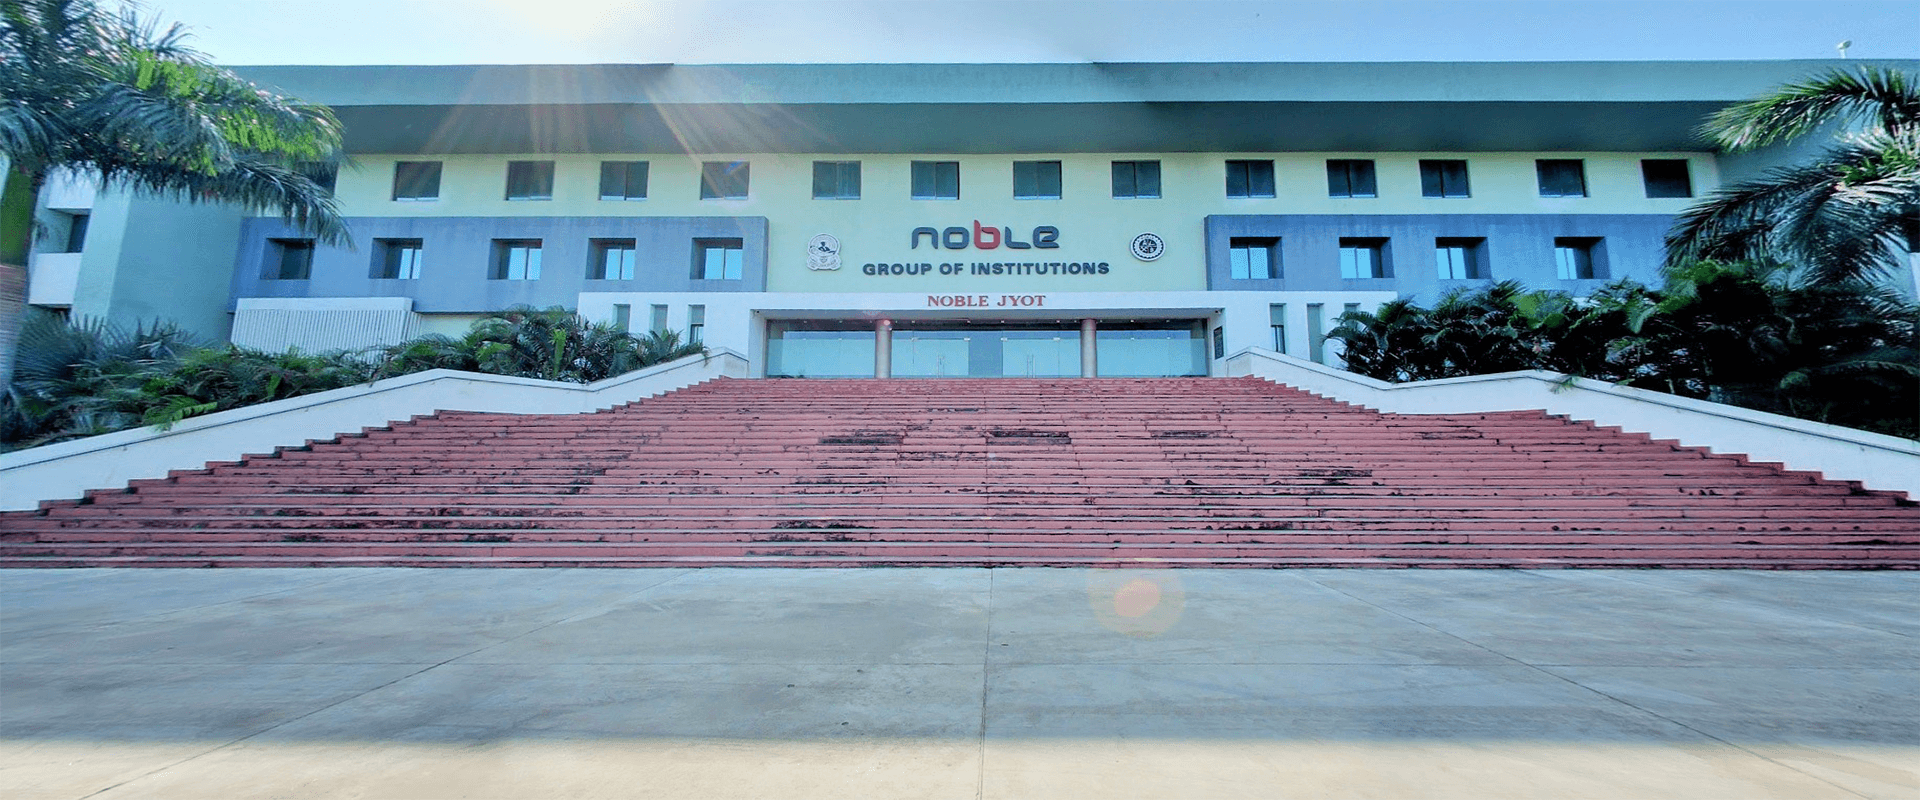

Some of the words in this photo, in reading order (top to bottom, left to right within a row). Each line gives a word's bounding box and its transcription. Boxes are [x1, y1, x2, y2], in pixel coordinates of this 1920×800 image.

[862, 263, 933, 276] GROUP
[939, 263, 964, 275] OF
[971, 262, 1110, 275] INSTITUTIONS
[927, 295, 989, 307] NOBLE
[997, 295, 1046, 307] JYOT
